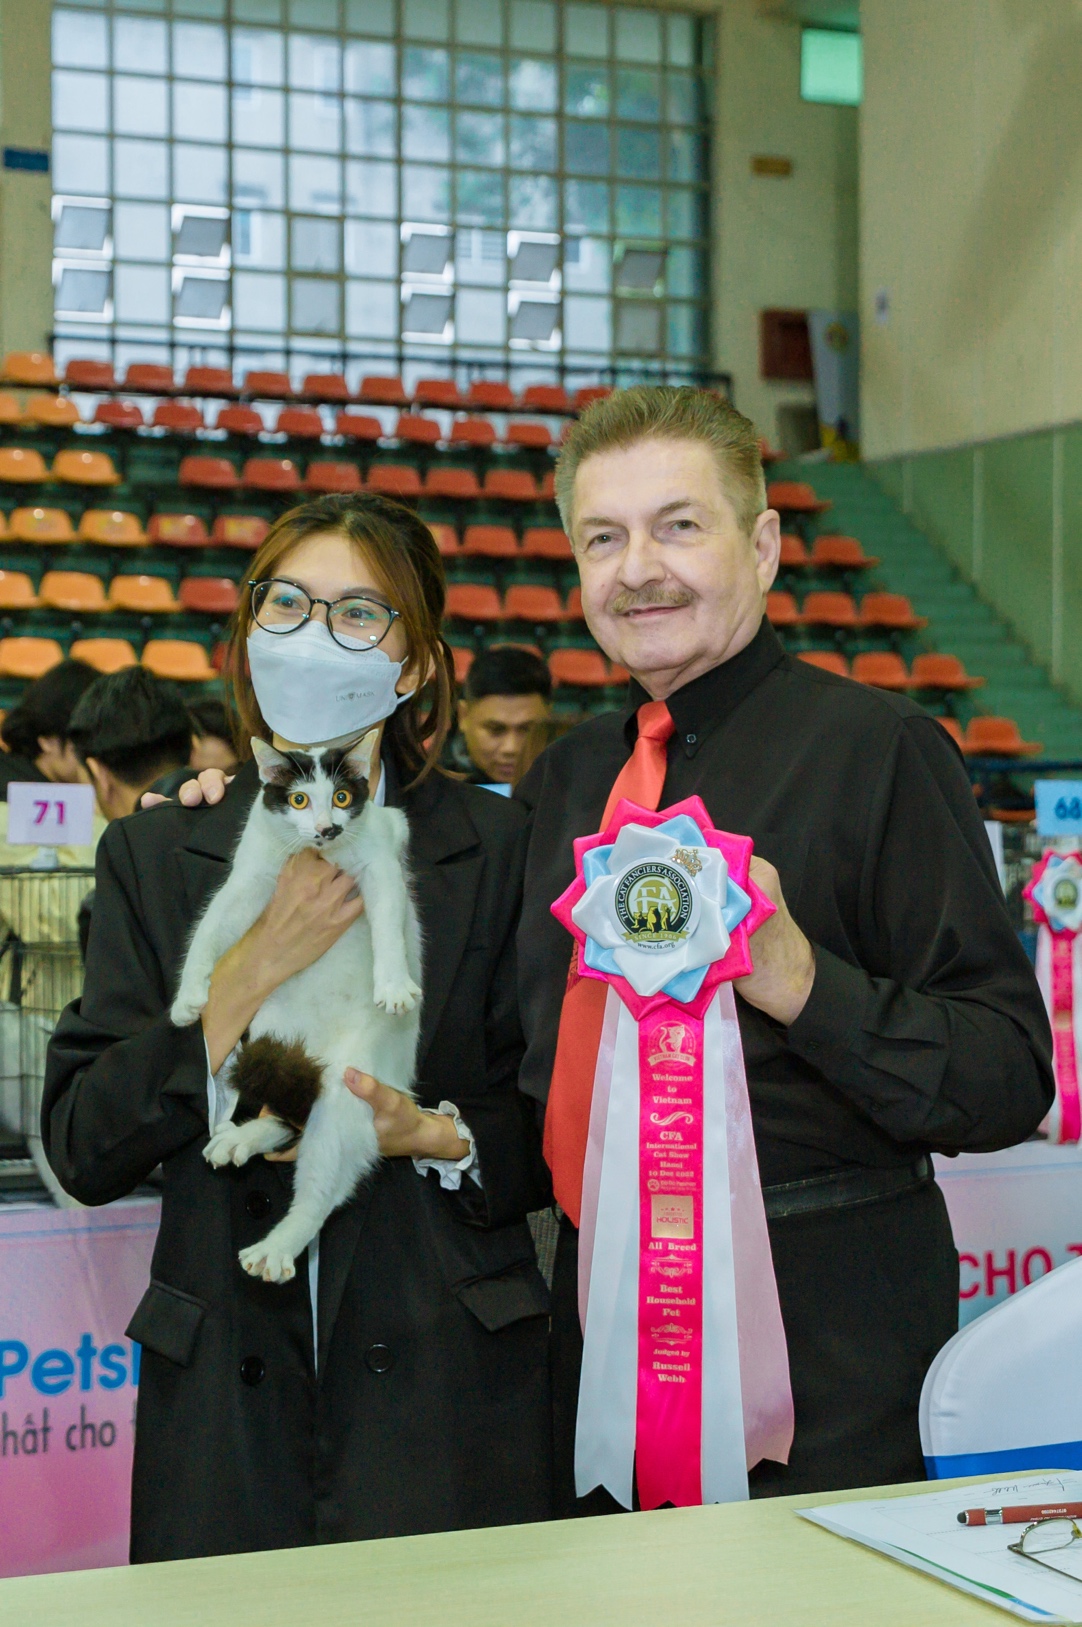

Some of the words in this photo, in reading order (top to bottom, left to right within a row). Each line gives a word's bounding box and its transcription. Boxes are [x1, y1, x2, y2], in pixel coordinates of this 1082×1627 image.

[33, 800, 66, 825] 71
[618, 884, 628, 902] CAT
[661, 867, 690, 919] ASSOCIATION
[618, 902, 628, 919] THE
[634, 933, 657, 941] SINCE
[637, 942, 676, 950] www.cfa.org
[652, 1073, 693, 1081] Welcome
[667, 1085, 677, 1093] to
[653, 1096, 692, 1104] Vietnam
[660, 1131, 683, 1141] CFA
[646, 1142, 697, 1150] International
[656, 1216, 689, 1224] HOLISTIC
[648, 1241, 662, 1250] All
[667, 1242, 696, 1251] Breed
[660, 1284, 683, 1294] Best
[646, 1295, 696, 1305] Household
[662, 1308, 681, 1317] Pet
[653, 1348, 680, 1357] Judged
[681, 1350, 690, 1358] by
[652, 1361, 690, 1371] Russell
[657, 1373, 686, 1383] Webb
[65, 1404, 116, 1451] cho
